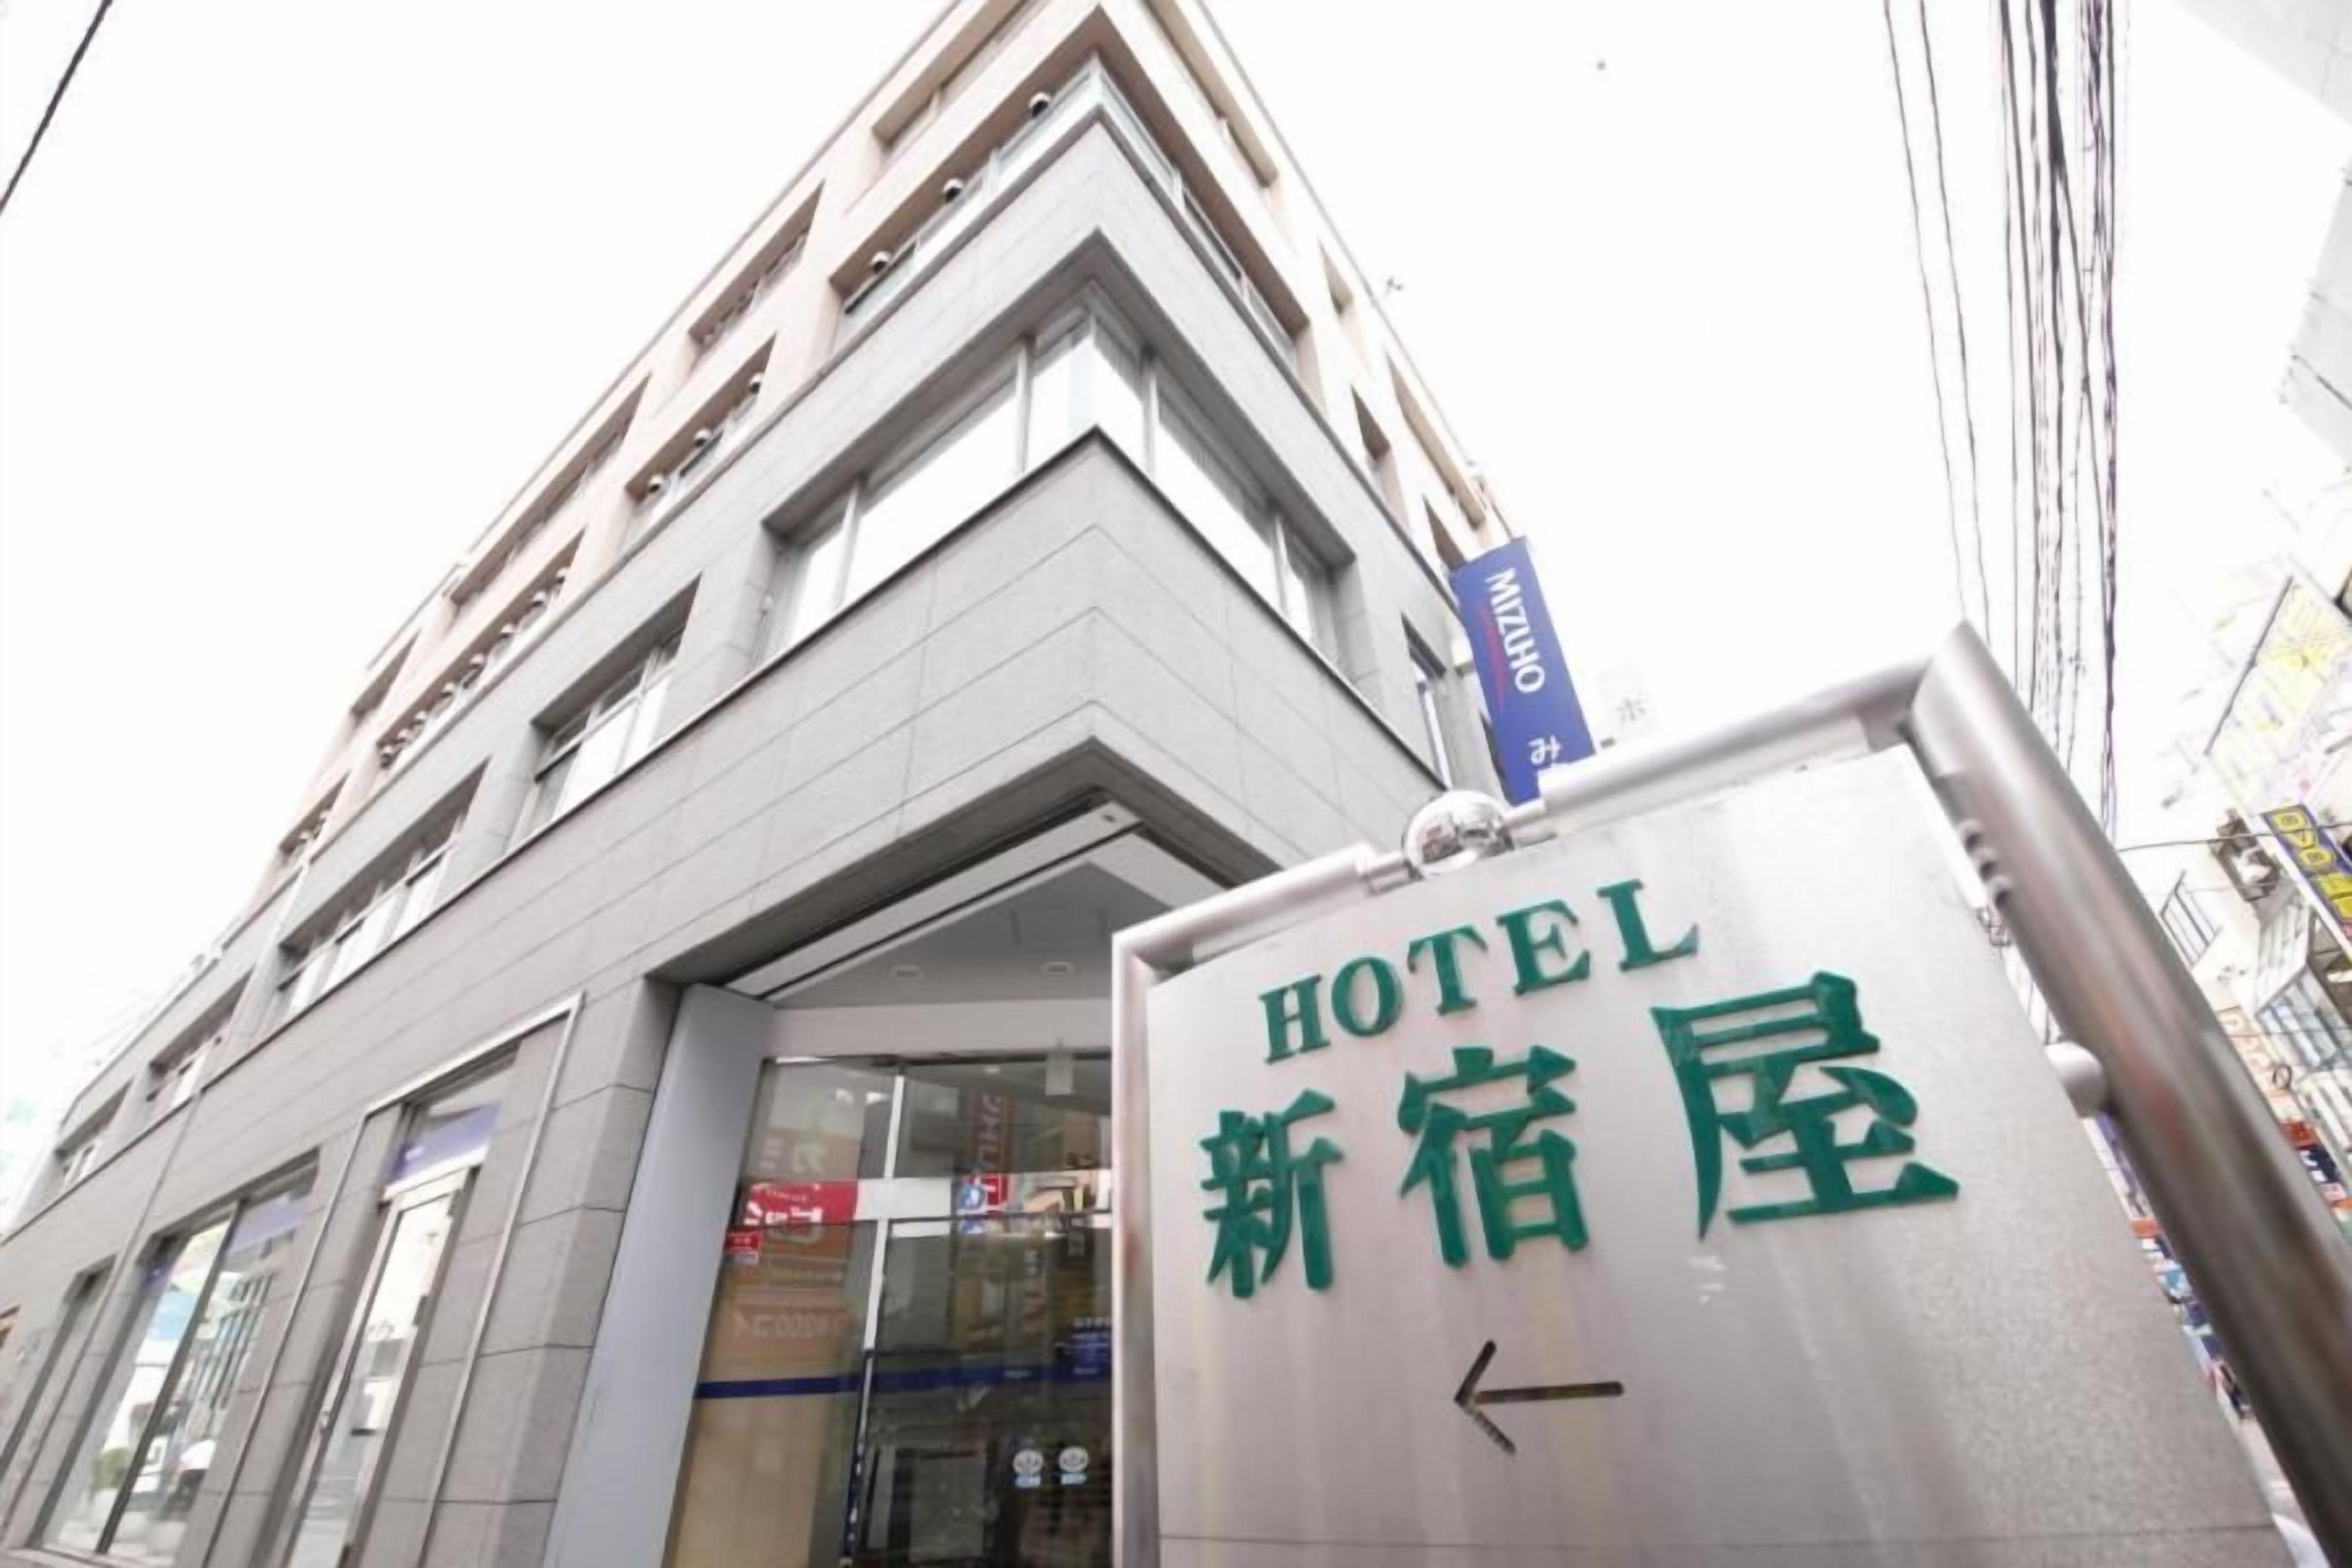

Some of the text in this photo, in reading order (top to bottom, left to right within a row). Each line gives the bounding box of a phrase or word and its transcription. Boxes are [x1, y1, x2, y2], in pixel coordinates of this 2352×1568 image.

[1484, 567, 1546, 693] MIZUHO
[1258, 878, 1699, 1064] HOTEL
[1200, 970, 1960, 1300] 新宿屋
